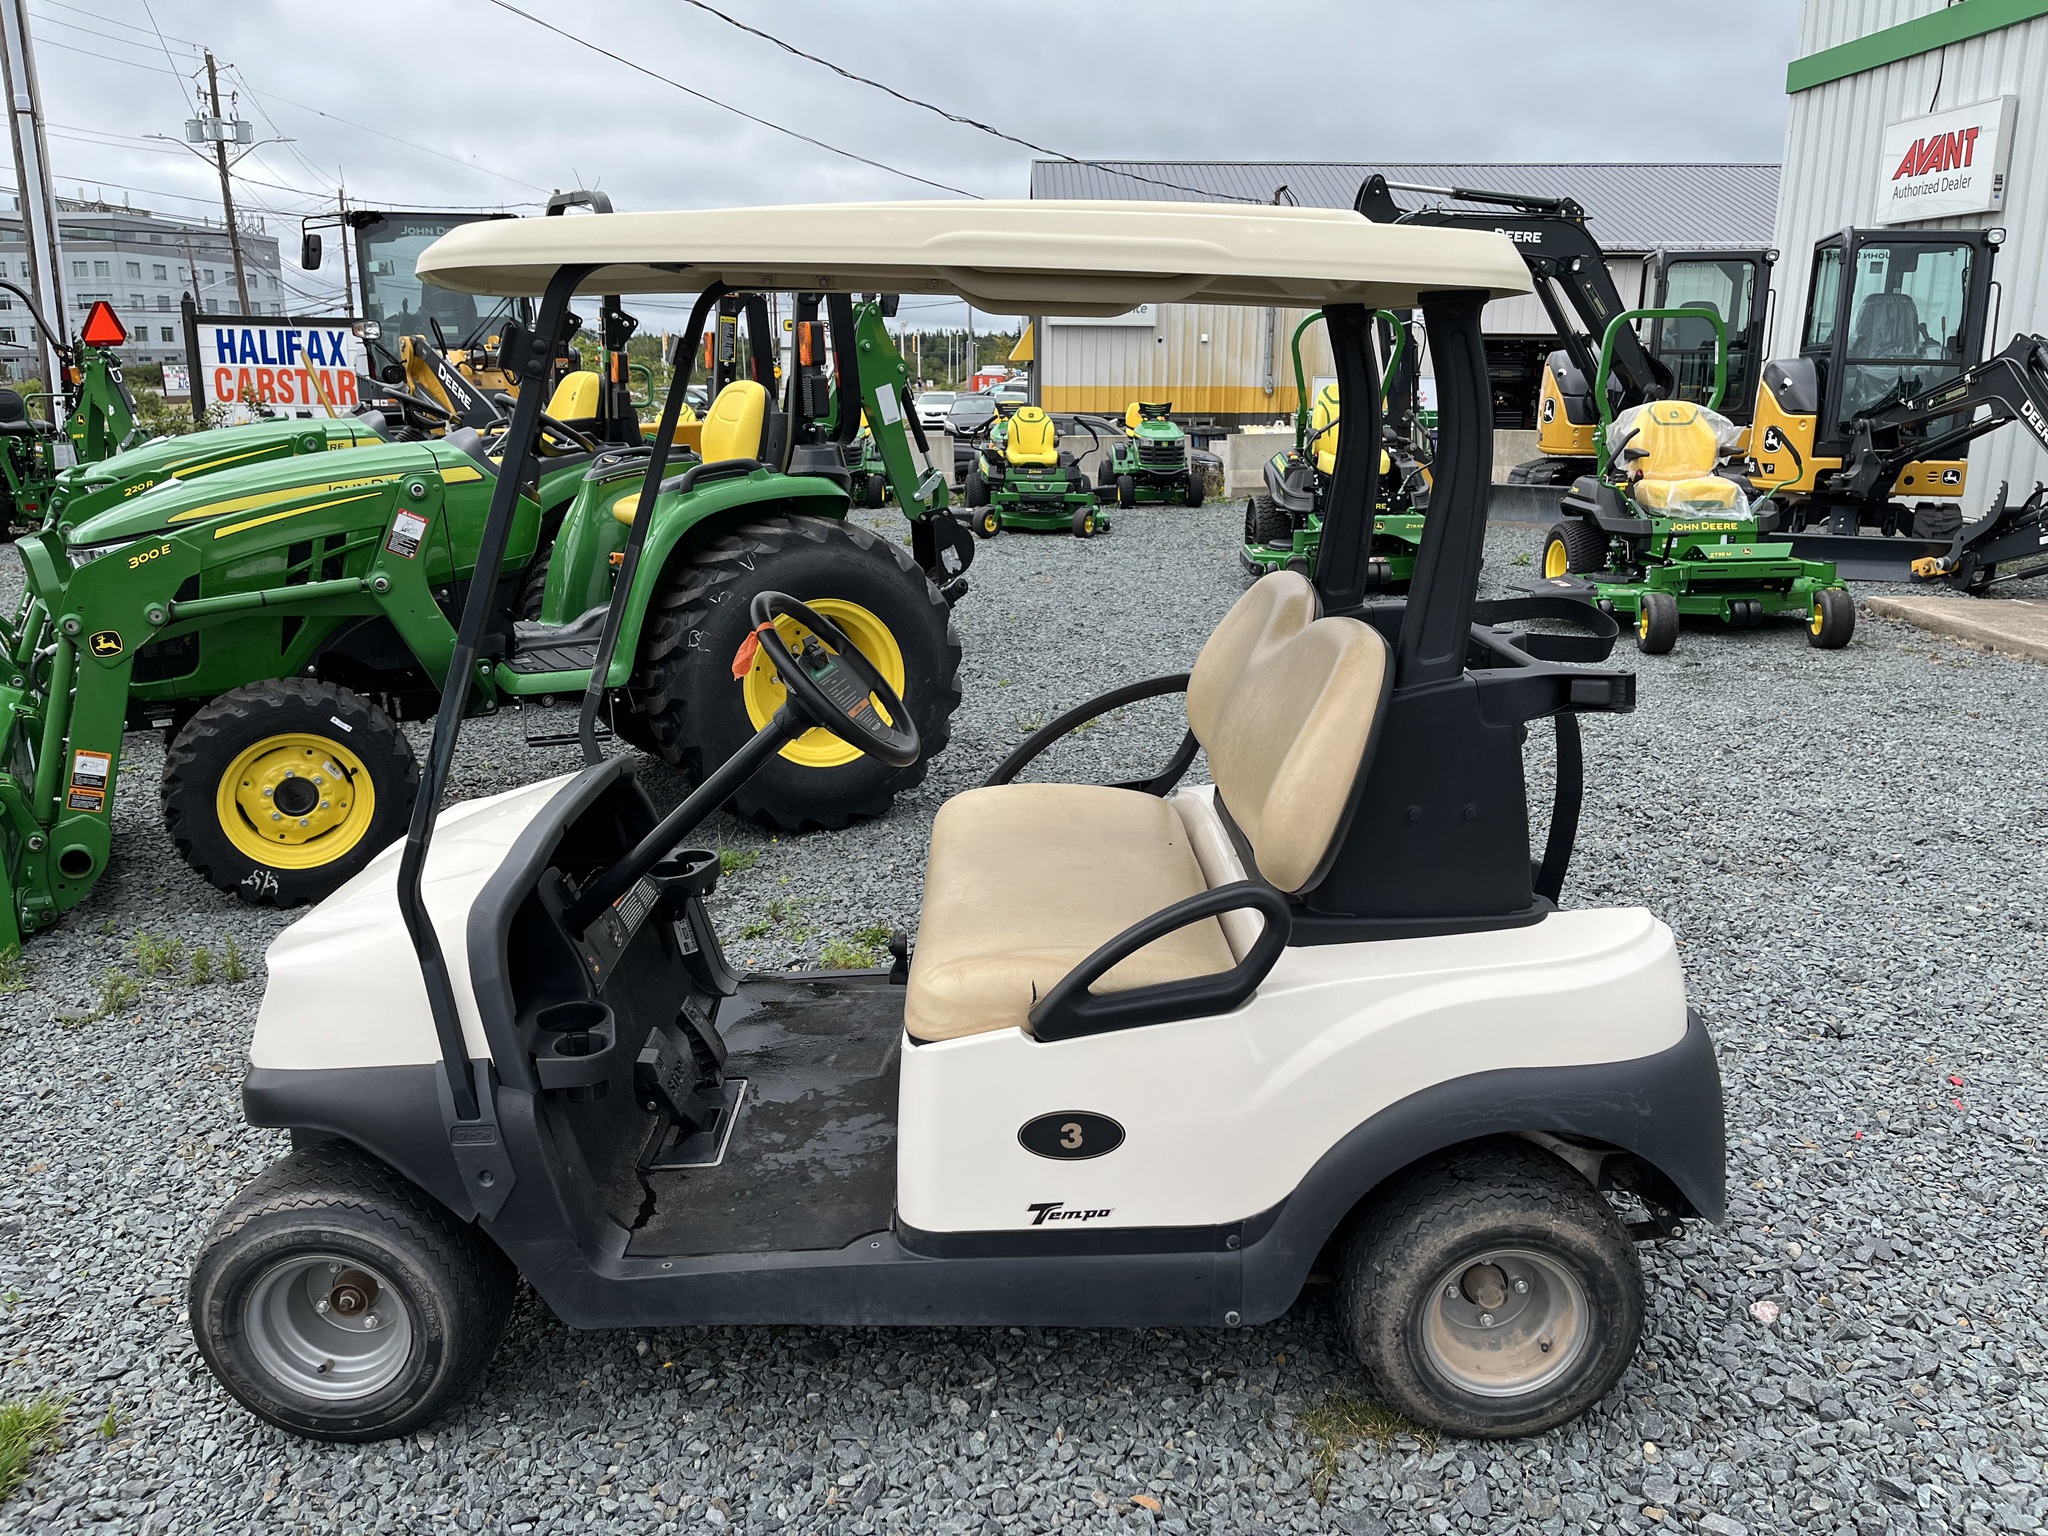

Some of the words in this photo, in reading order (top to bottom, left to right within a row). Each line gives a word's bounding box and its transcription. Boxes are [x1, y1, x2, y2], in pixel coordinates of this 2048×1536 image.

[1892, 126, 1979, 181] AVANT
[1892, 178, 1940, 200] Authorized
[1941, 173, 1972, 192] Dealer
[400, 225, 434, 236] JOHN
[215, 328, 348, 367] HALIFAX
[214, 367, 359, 406] CARSTAR
[438, 362, 472, 411] DEERE
[124, 483, 146, 497] 220
[146, 480, 154, 489] R
[1670, 522, 1700, 531] JOHN
[1701, 521, 1738, 530] DEERE
[128, 548, 160, 570] 300
[161, 543, 172, 556] E
[1060, 1122, 1084, 1150] 3
[1027, 1201, 1113, 1226] Tempo
